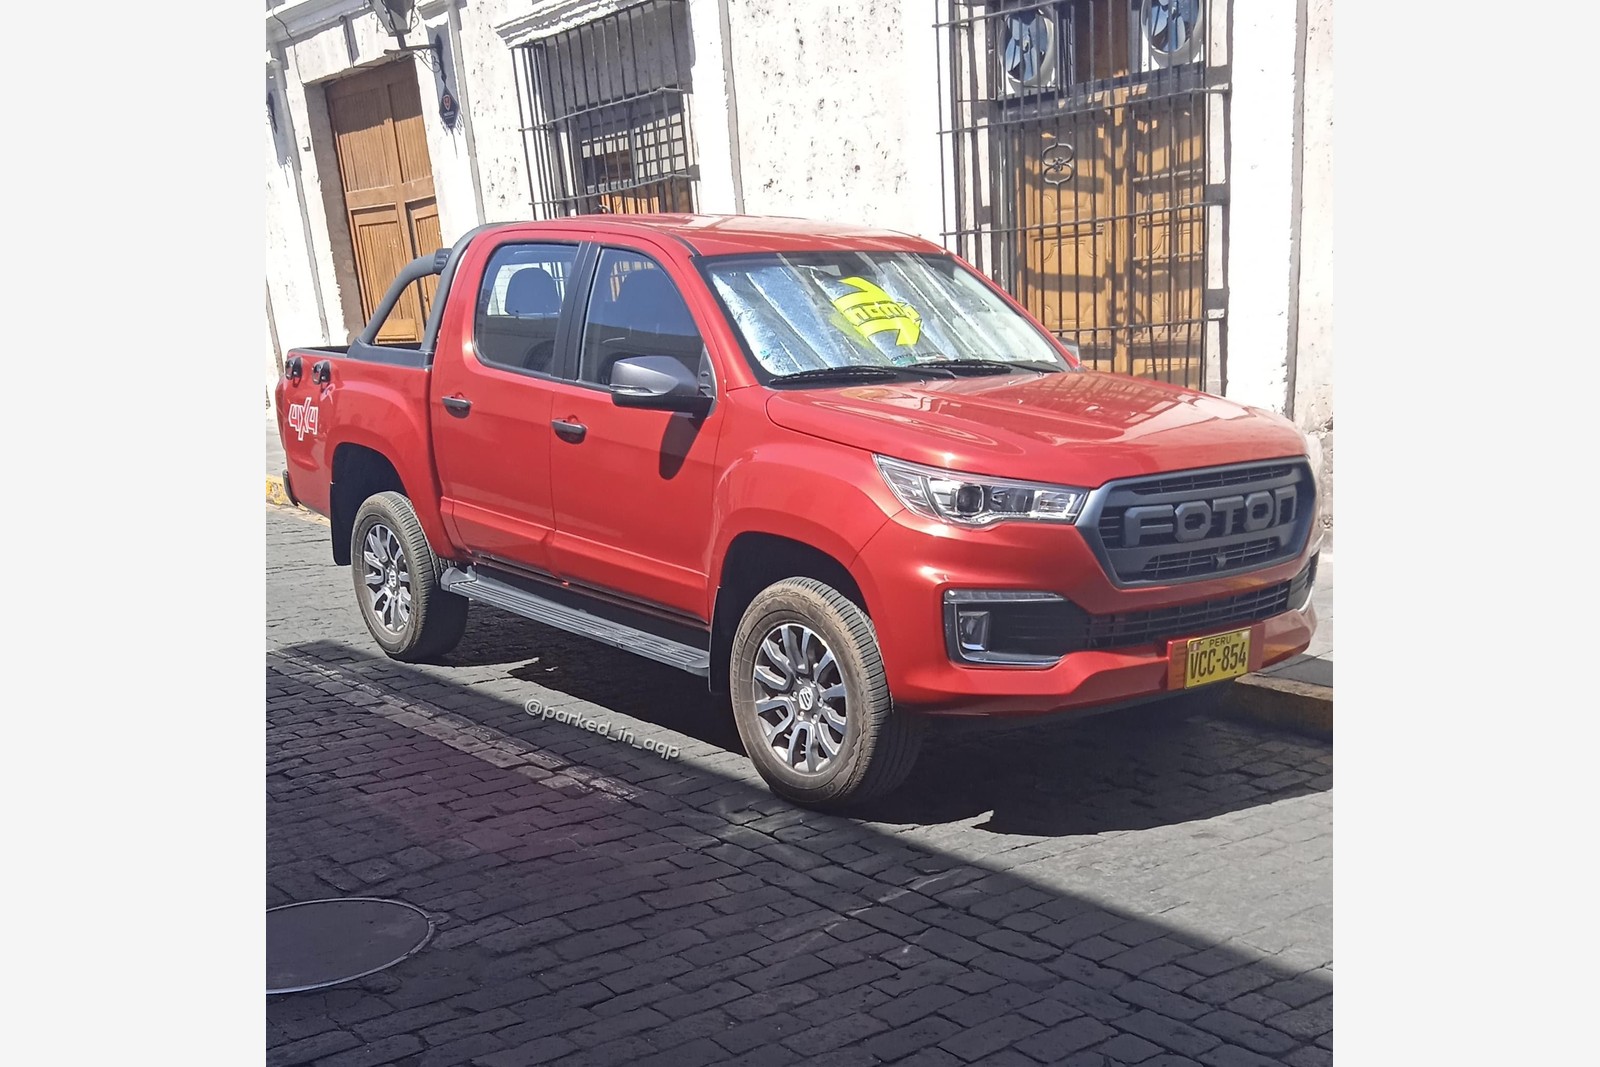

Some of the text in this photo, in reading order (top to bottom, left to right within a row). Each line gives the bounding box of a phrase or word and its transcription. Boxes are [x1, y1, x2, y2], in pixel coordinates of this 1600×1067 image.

[1123, 485, 1297, 547] FOTON
[1209, 636, 1231, 647] PERU
[1190, 642, 1246, 679] VCC-854
